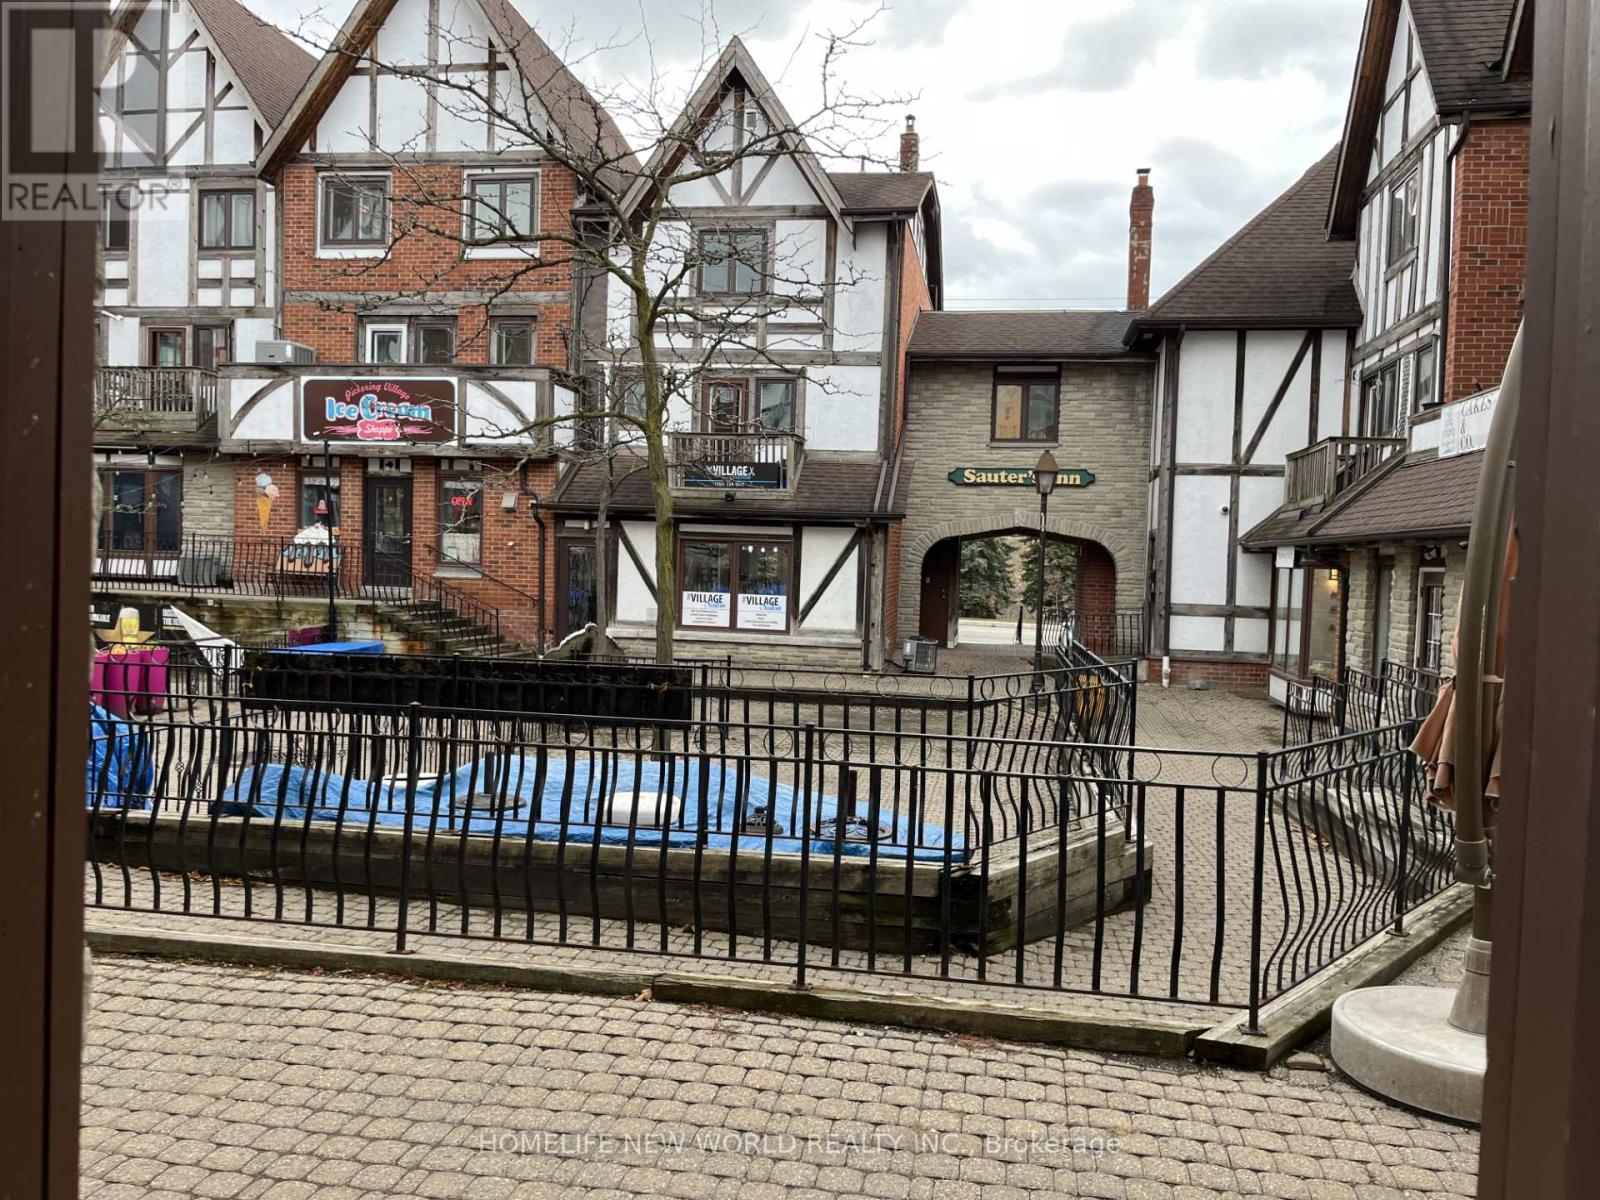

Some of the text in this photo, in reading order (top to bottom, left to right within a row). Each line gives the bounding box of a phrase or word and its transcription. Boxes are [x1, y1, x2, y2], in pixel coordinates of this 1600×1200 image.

[345, 382, 411, 401] Pickering Village
[325, 394, 432, 421] Ice Cream
[713, 465, 749, 476] VILLAGE
[1056, 474, 1081, 485] nn
[691, 593, 724, 604] VILLAGE
[746, 596, 779, 606] VILLAGE
